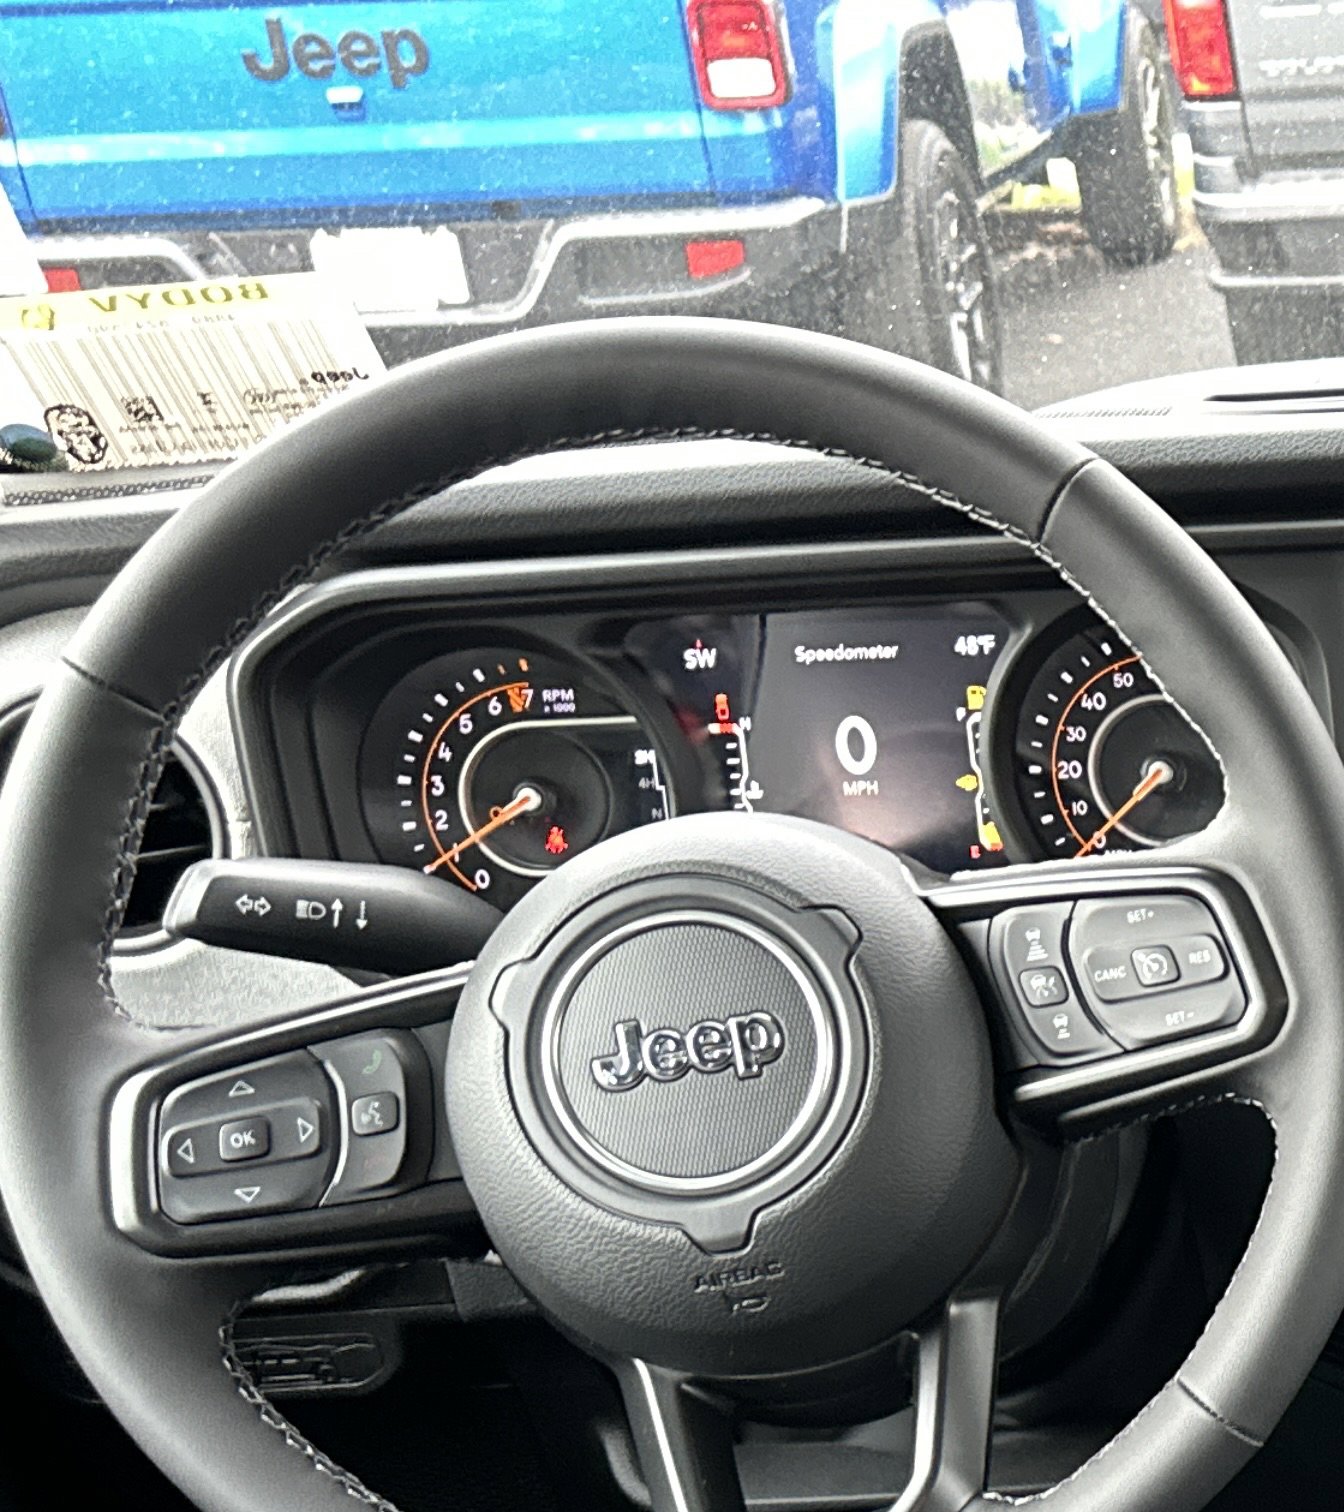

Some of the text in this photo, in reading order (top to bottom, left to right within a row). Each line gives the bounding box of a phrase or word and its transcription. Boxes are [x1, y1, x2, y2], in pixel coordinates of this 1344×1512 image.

[241, 18, 430, 88] Jeep
[683, 648, 716, 670] SW
[794, 644, 899, 665] Speedometer
[1113, 673, 1134, 687] 50
[542, 689, 574, 702] RPM
[1081, 693, 1106, 710] 40
[488, 696, 501, 716] 6
[459, 713, 473, 734] 5
[1066, 727, 1086, 742] 30
[438, 743, 452, 762] 4
[835, 715, 877, 775] 0
[1058, 761, 1082, 779] 20
[431, 775, 444, 795] 3
[843, 780, 878, 796] MPH
[1072, 801, 1087, 815] 10
[435, 810, 448, 830] 2
[475, 869, 489, 888] 0
[1094, 966, 1127, 982] CANC
[591, 1010, 785, 1093] Jeep
[230, 1130, 256, 1148] OK
[694, 1261, 785, 1293] AIRBAG
